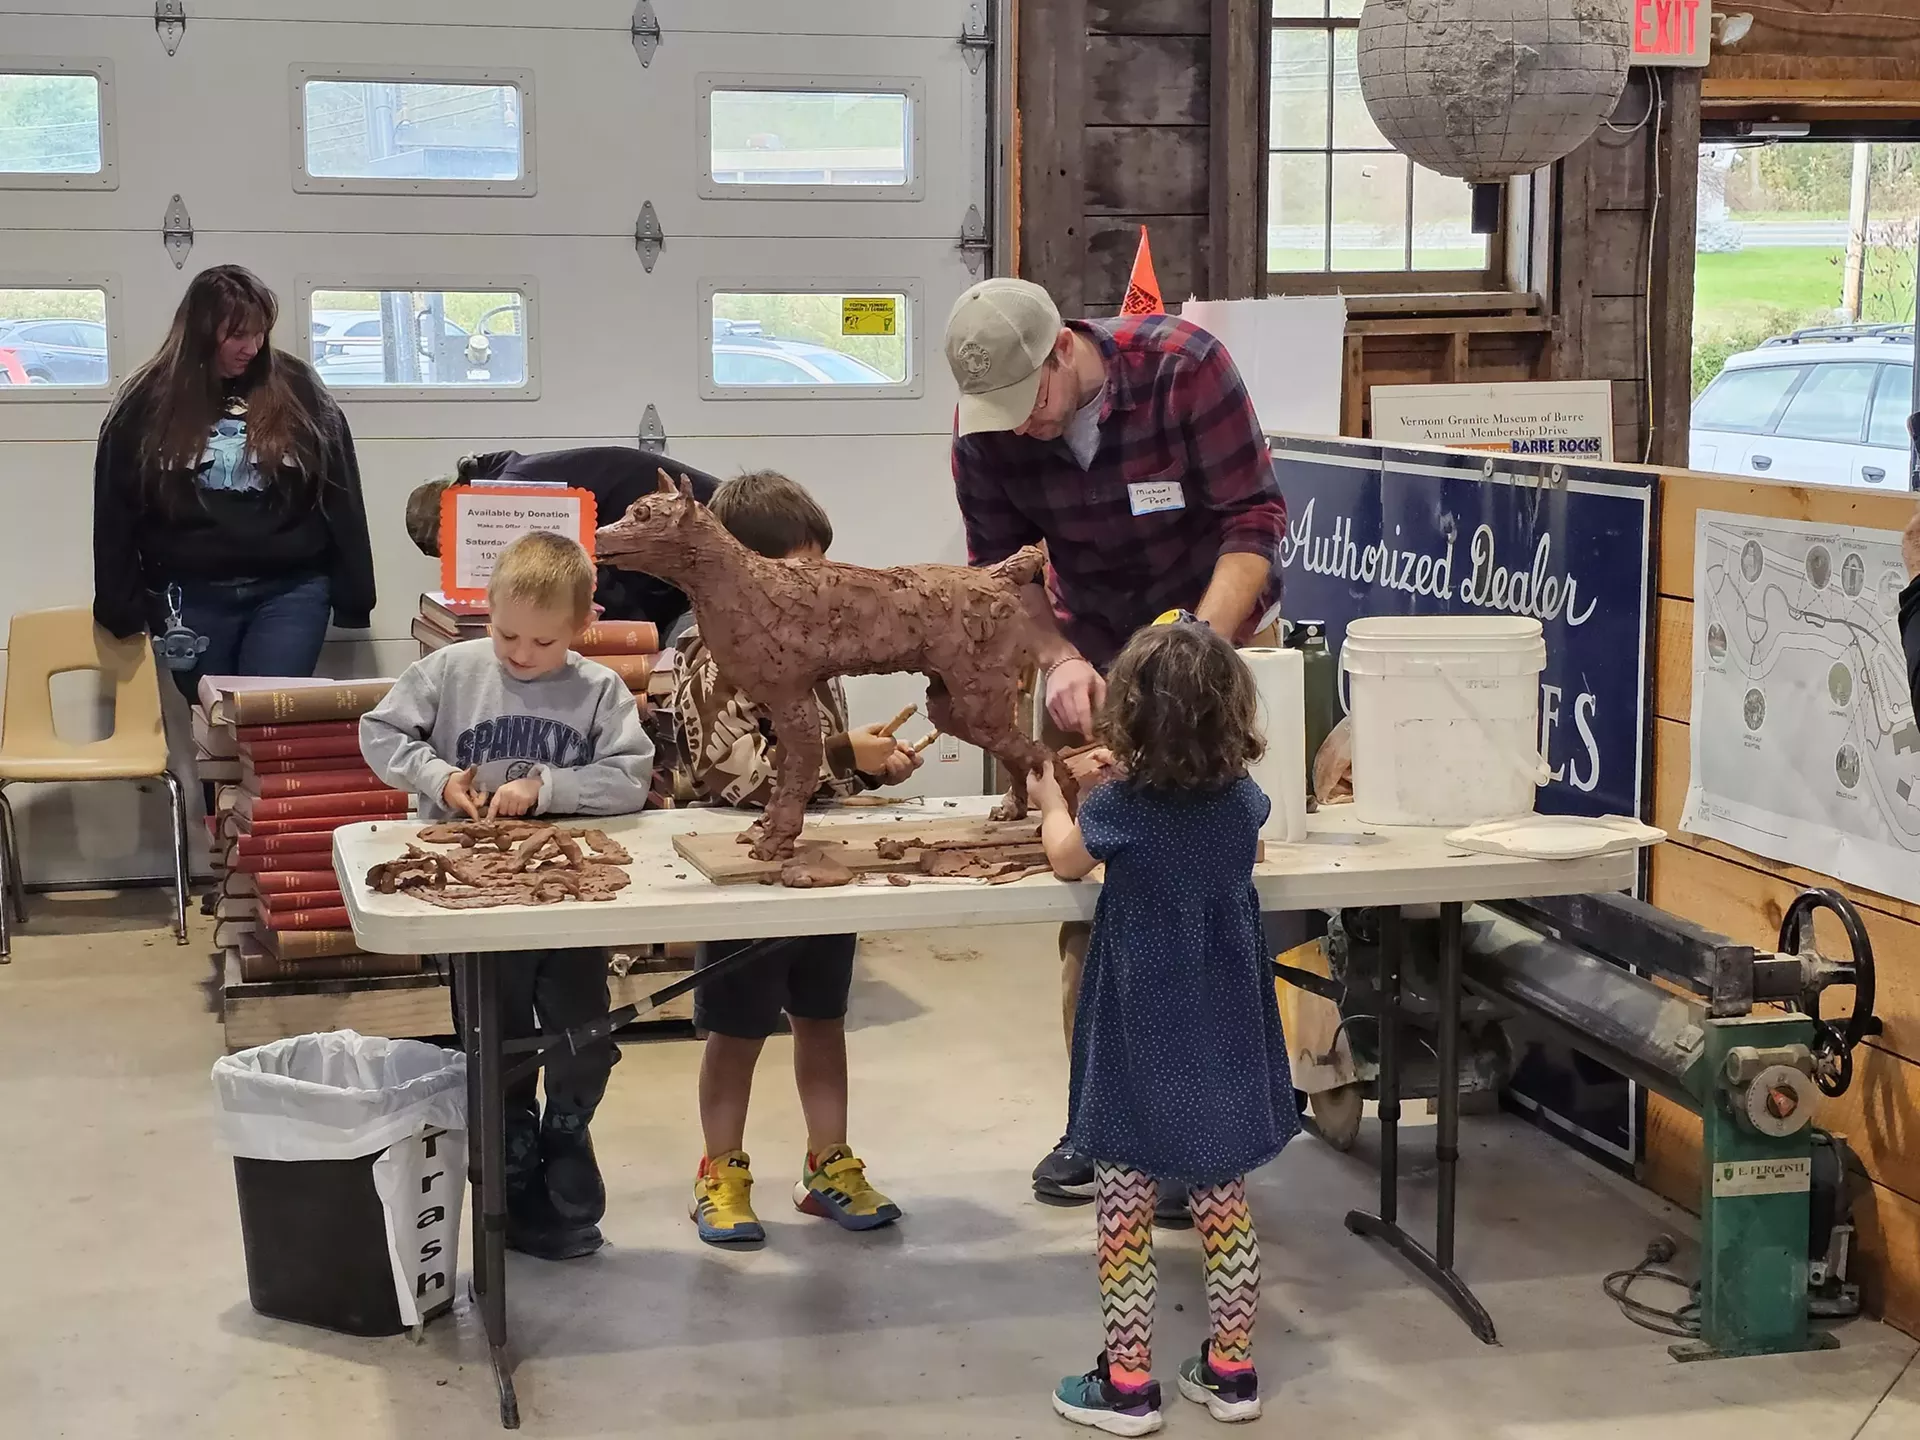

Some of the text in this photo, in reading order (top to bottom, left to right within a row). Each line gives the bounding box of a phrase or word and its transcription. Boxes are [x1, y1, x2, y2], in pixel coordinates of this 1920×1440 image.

[1634, 0, 1700, 55] EXIT
[1400, 411, 1584, 427] Vermont Granite Museum of Barre
[1423, 426, 1569, 439] Annual Membership Drive
[1511, 438, 1600, 453] BARRE ROCKS
[1135, 486, 1171, 496] Michael
[467, 508, 570, 519] Available by Donation
[481, 552, 498, 560] 193
[1279, 497, 1598, 627] Authorized Dealer
[416, 1125, 448, 1299] Trash
